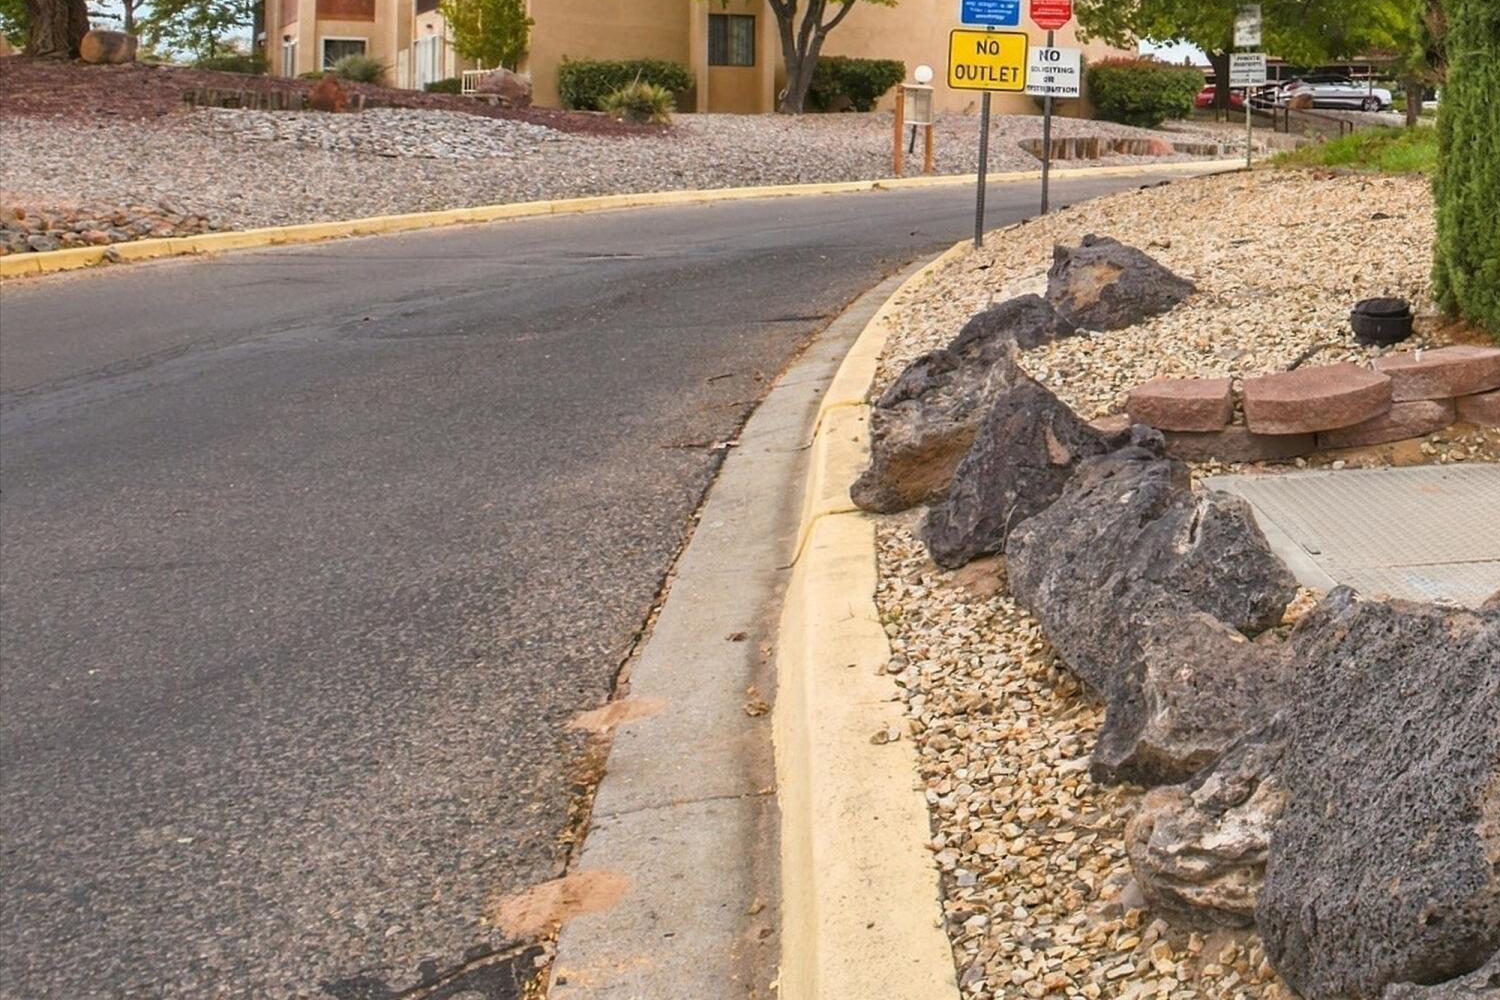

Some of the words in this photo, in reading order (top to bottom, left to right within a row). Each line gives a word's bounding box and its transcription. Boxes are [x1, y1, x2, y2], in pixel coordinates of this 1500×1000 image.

[976, 39, 1000, 55] NO
[1039, 49, 1060, 61] NO
[955, 64, 1020, 82] OUTLET
